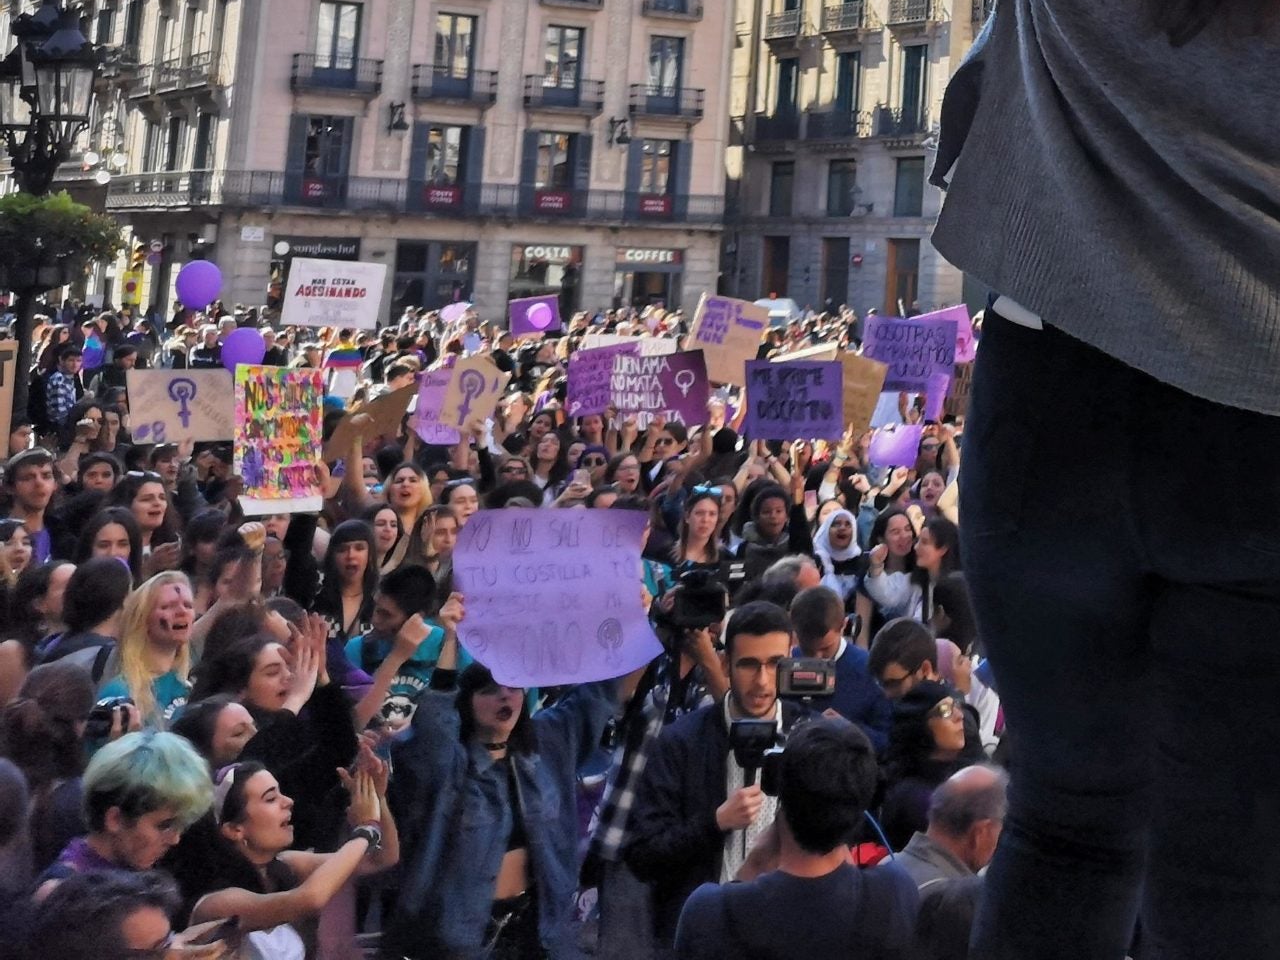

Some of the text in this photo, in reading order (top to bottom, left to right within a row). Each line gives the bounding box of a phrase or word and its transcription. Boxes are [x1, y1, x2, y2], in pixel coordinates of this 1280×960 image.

[524, 246, 572, 260] COSTA
[624, 249, 674, 262] COFFEE
[510, 517, 533, 548] NO
[464, 565, 498, 586] TU
[513, 563, 592, 584] COSTILLA
